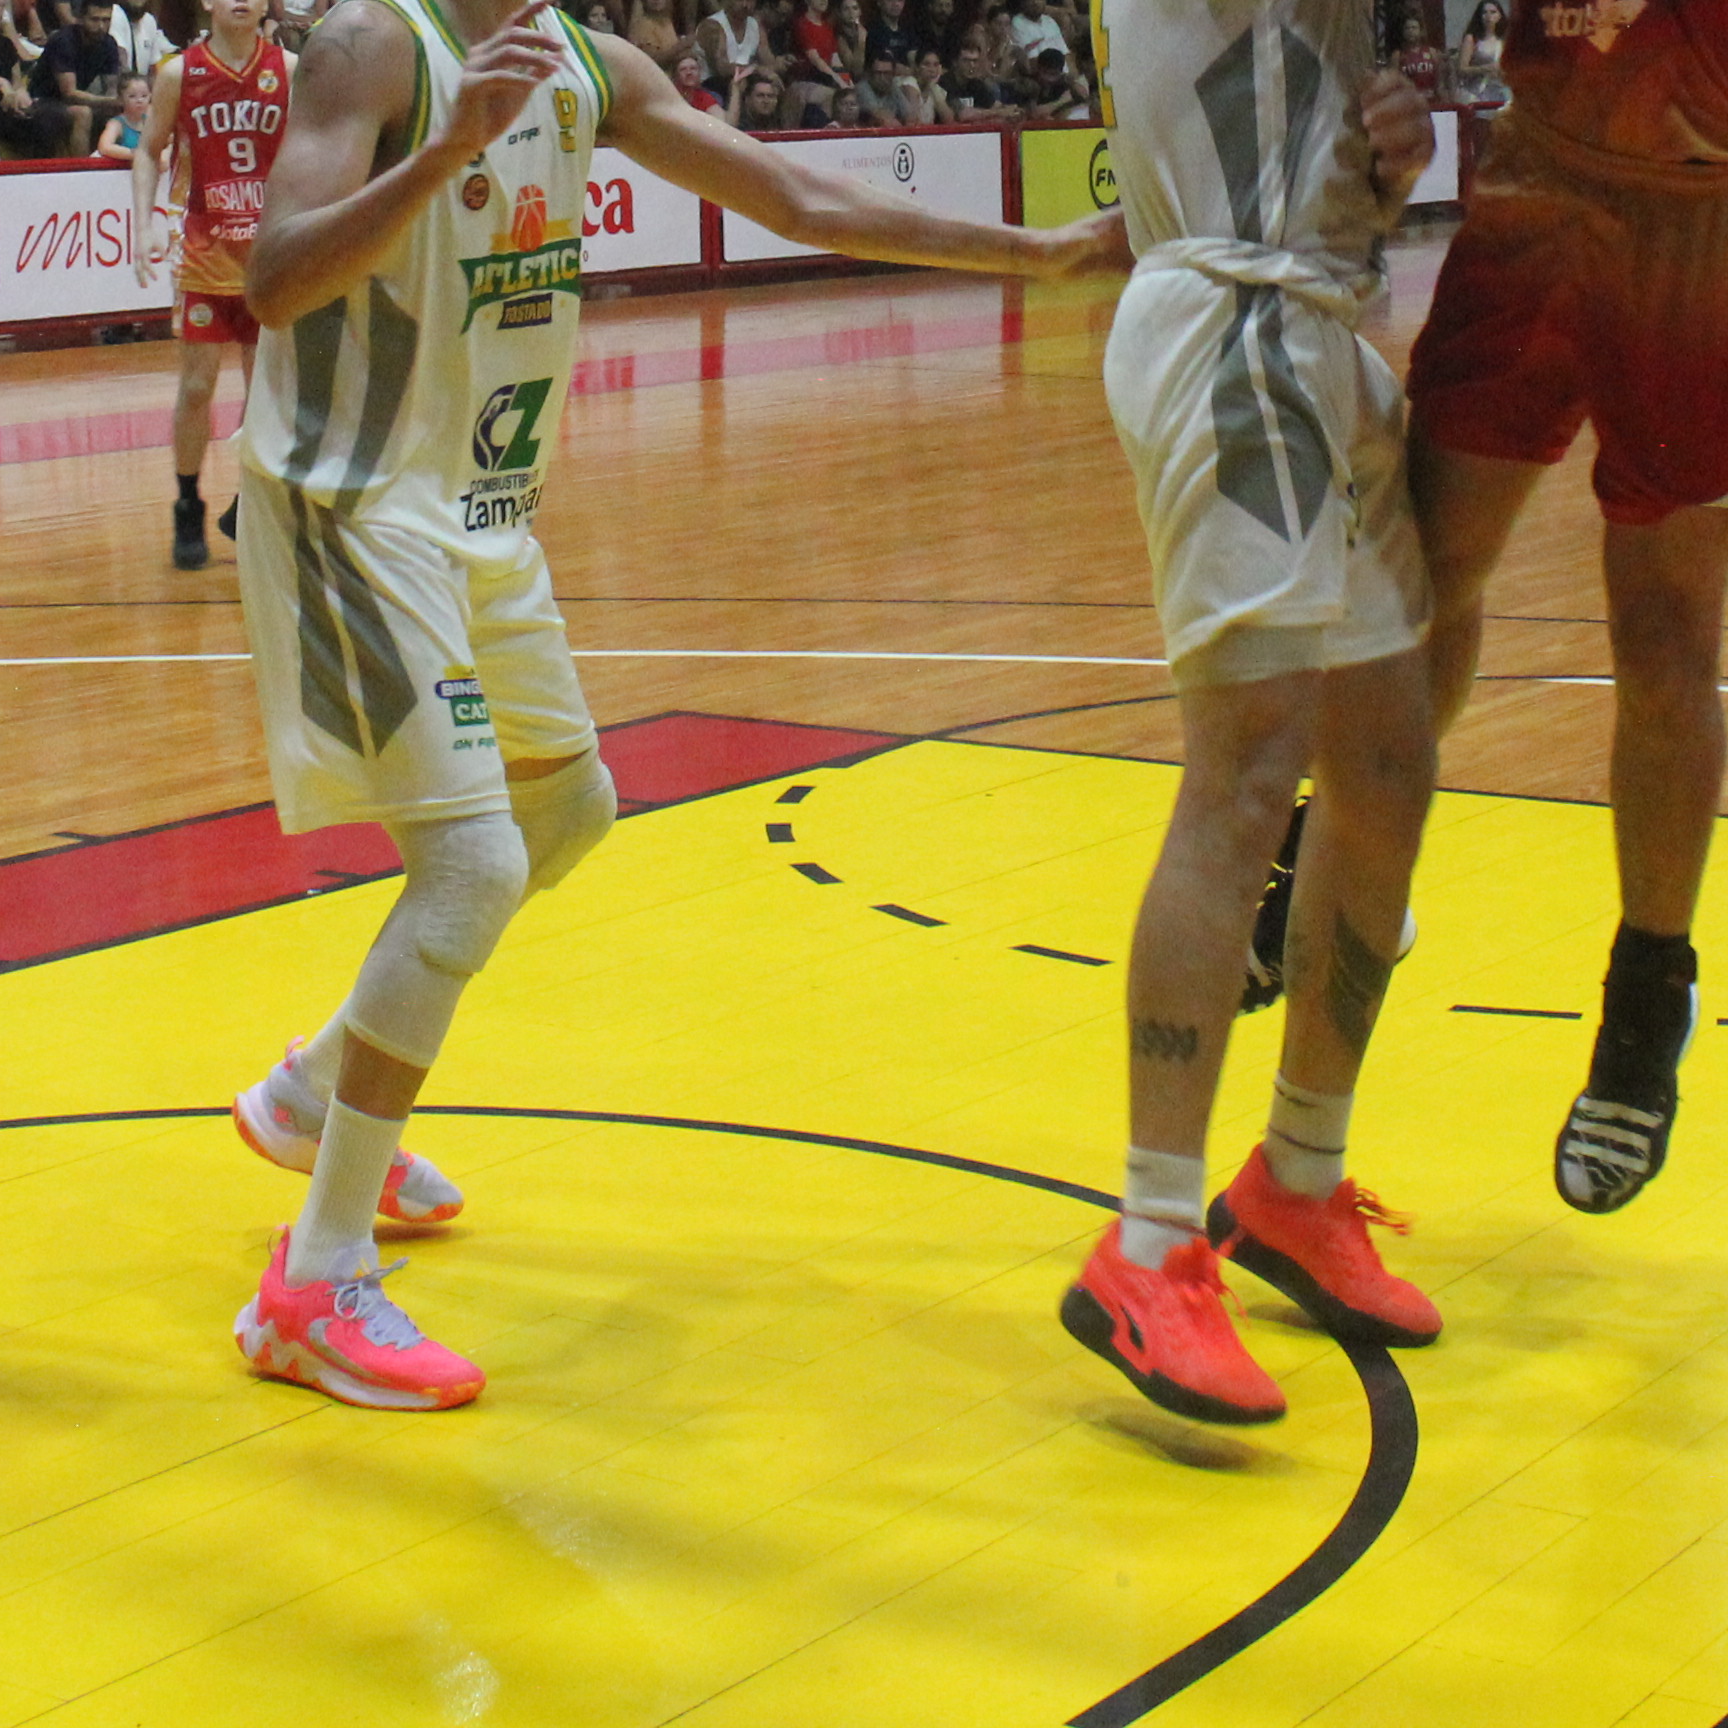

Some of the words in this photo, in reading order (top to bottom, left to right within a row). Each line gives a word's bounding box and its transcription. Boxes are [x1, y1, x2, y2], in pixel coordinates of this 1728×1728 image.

[191, 99, 282, 139] TOKIO
[227, 137, 257, 173] 9
[841, 156, 893, 170] ALIMENTOS
[472, 246, 581, 299] ATLETIC
